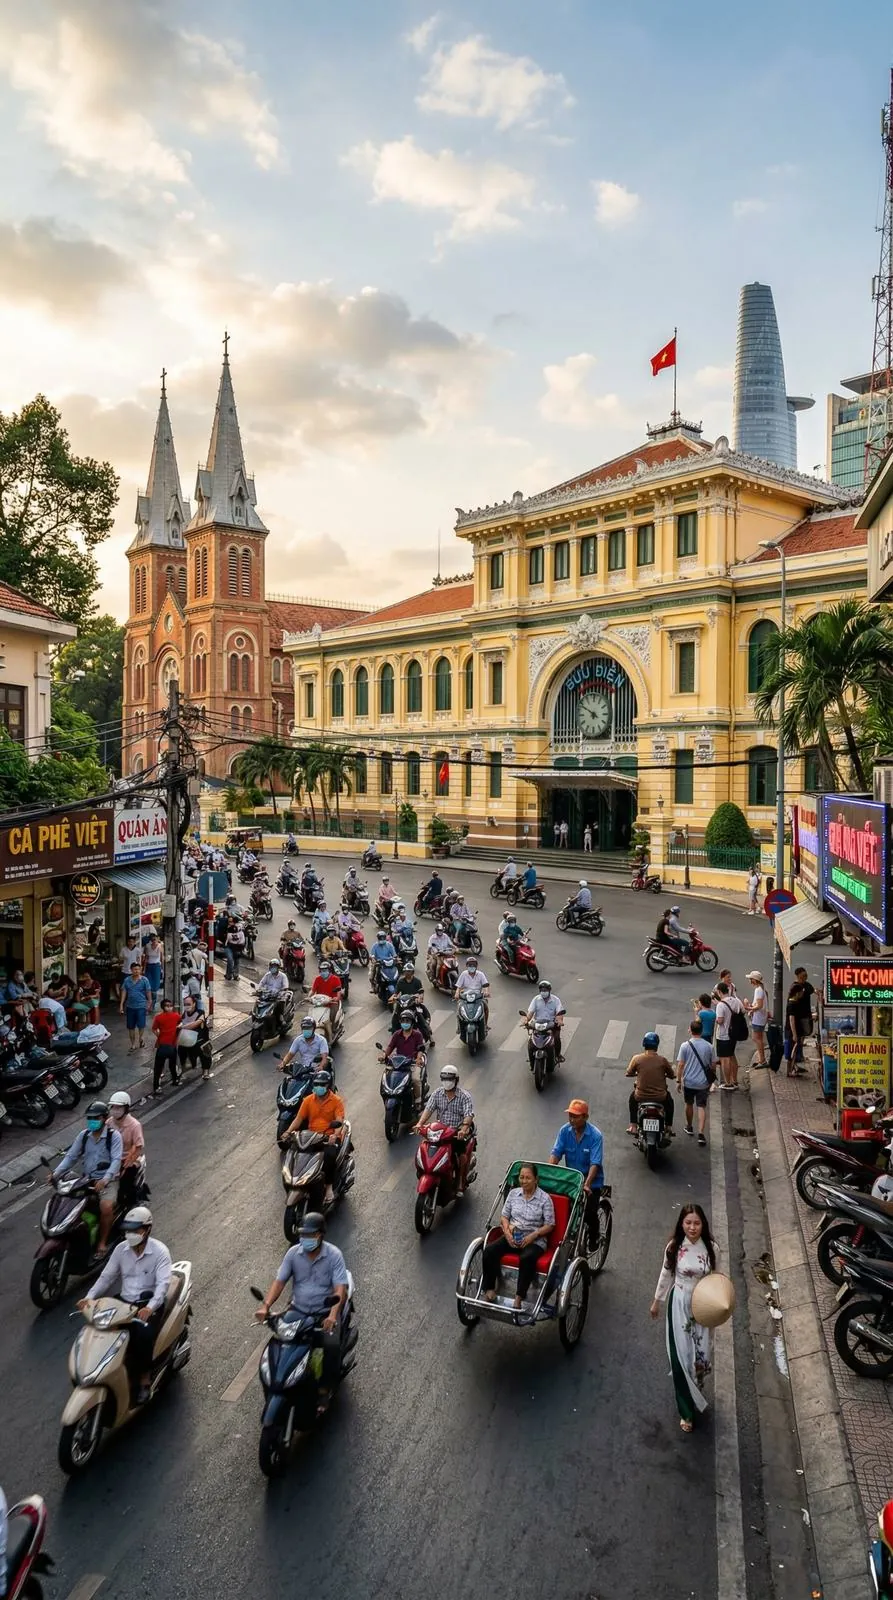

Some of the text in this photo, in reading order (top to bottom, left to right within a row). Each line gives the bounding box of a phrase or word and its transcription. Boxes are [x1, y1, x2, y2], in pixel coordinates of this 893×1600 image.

[38, 817, 71, 851] PHÊ
[75, 814, 107, 850] VIỆT
[118, 814, 149, 843] QUÁN
